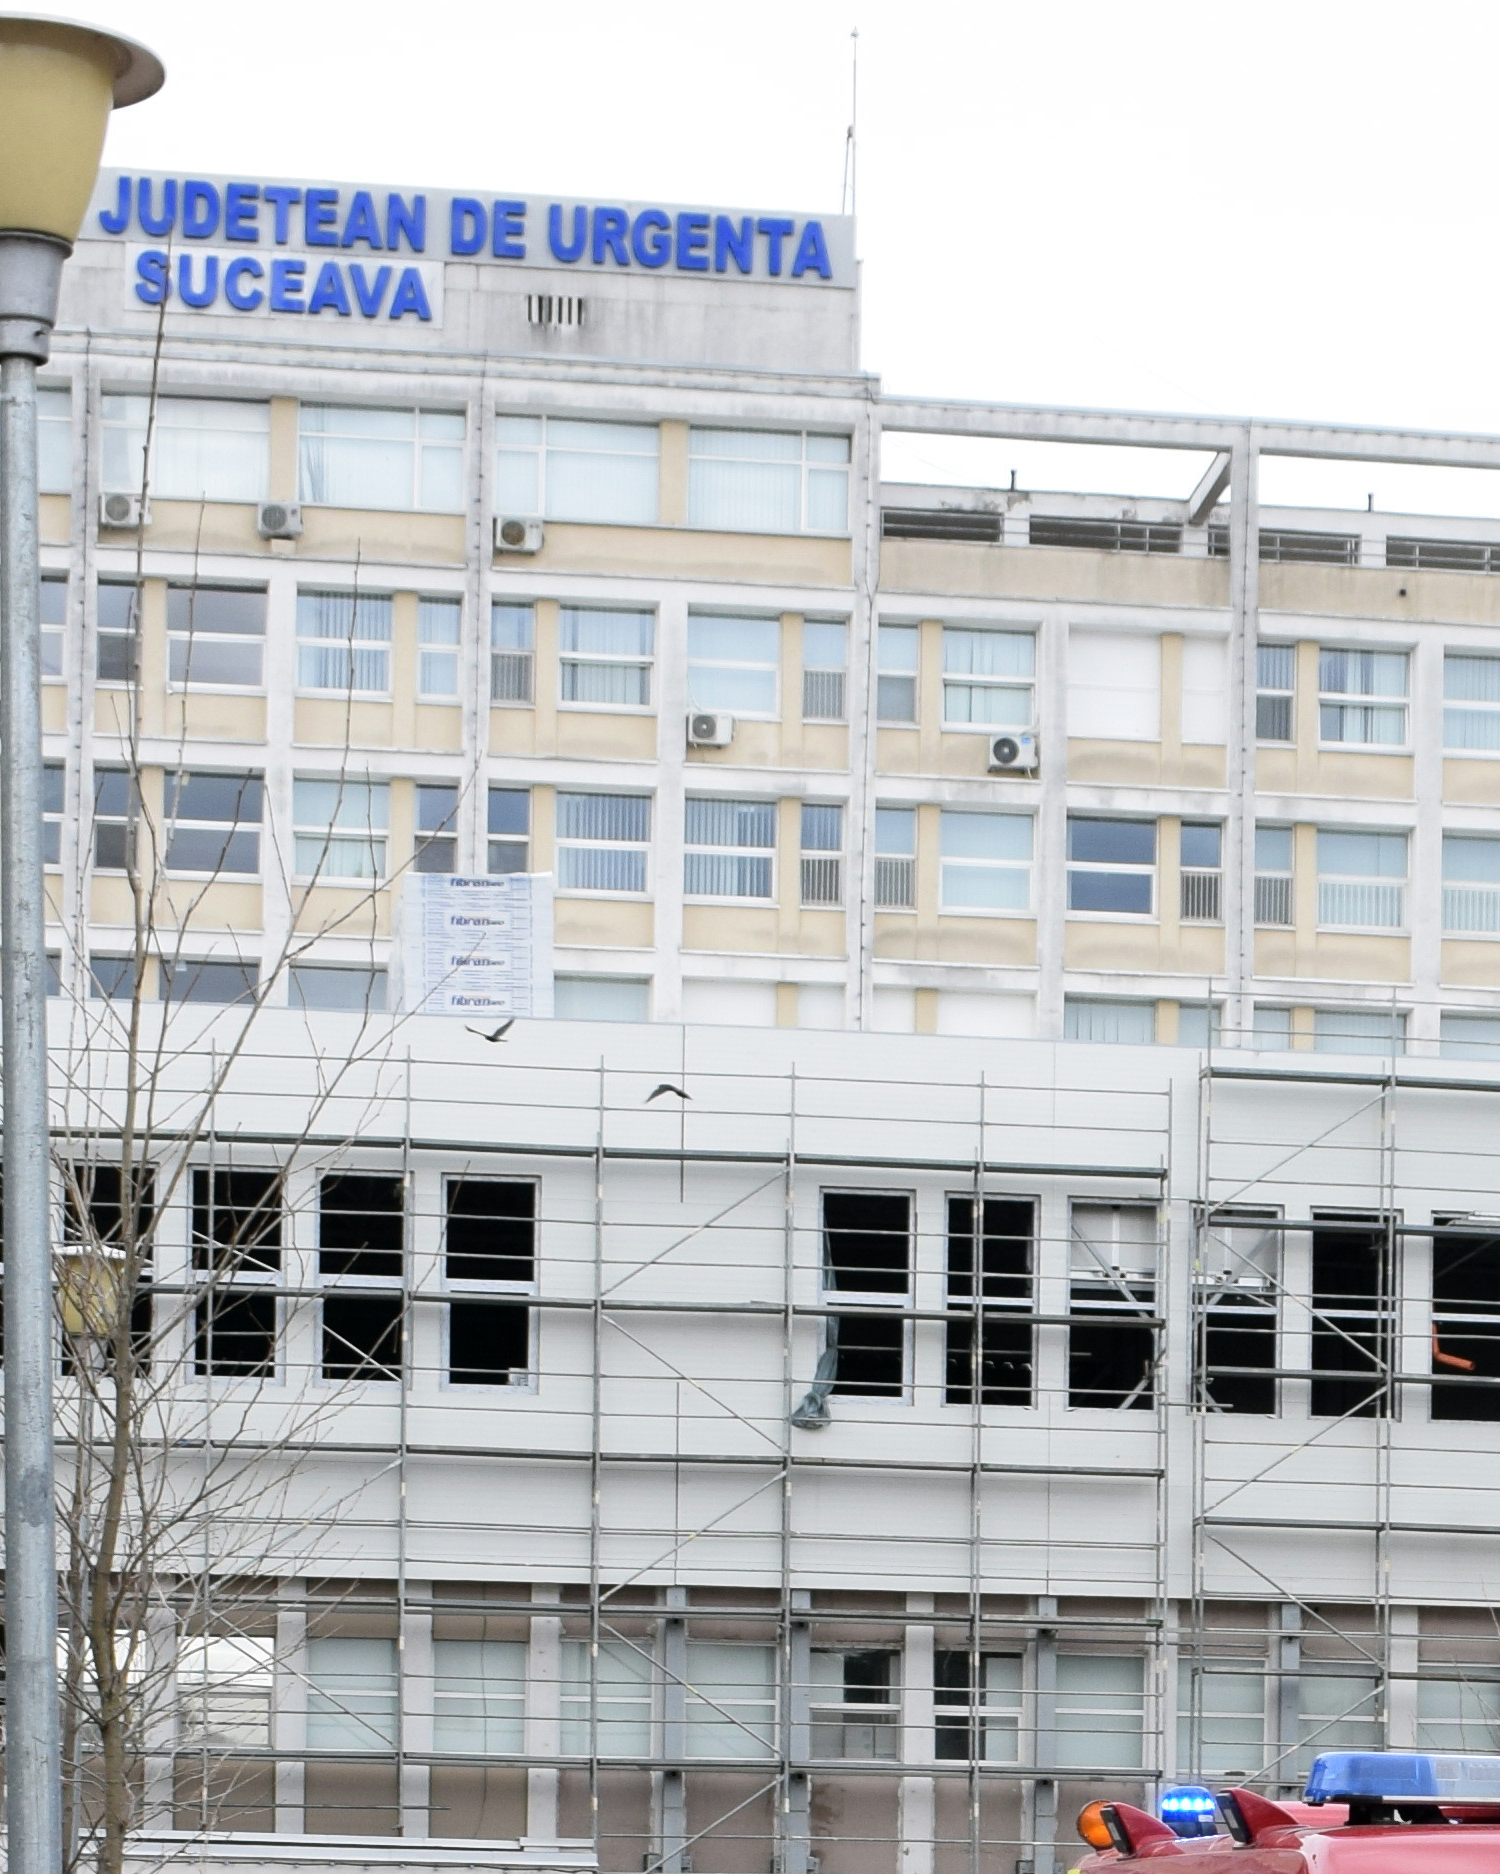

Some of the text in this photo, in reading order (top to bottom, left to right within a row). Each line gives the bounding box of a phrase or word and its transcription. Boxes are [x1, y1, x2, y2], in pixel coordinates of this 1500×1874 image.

[100, 176, 427, 254] JUDETEAN
[451, 197, 526, 259] DE
[549, 204, 832, 280] URGENTA
[135, 249, 433, 322] SUCEAVA
